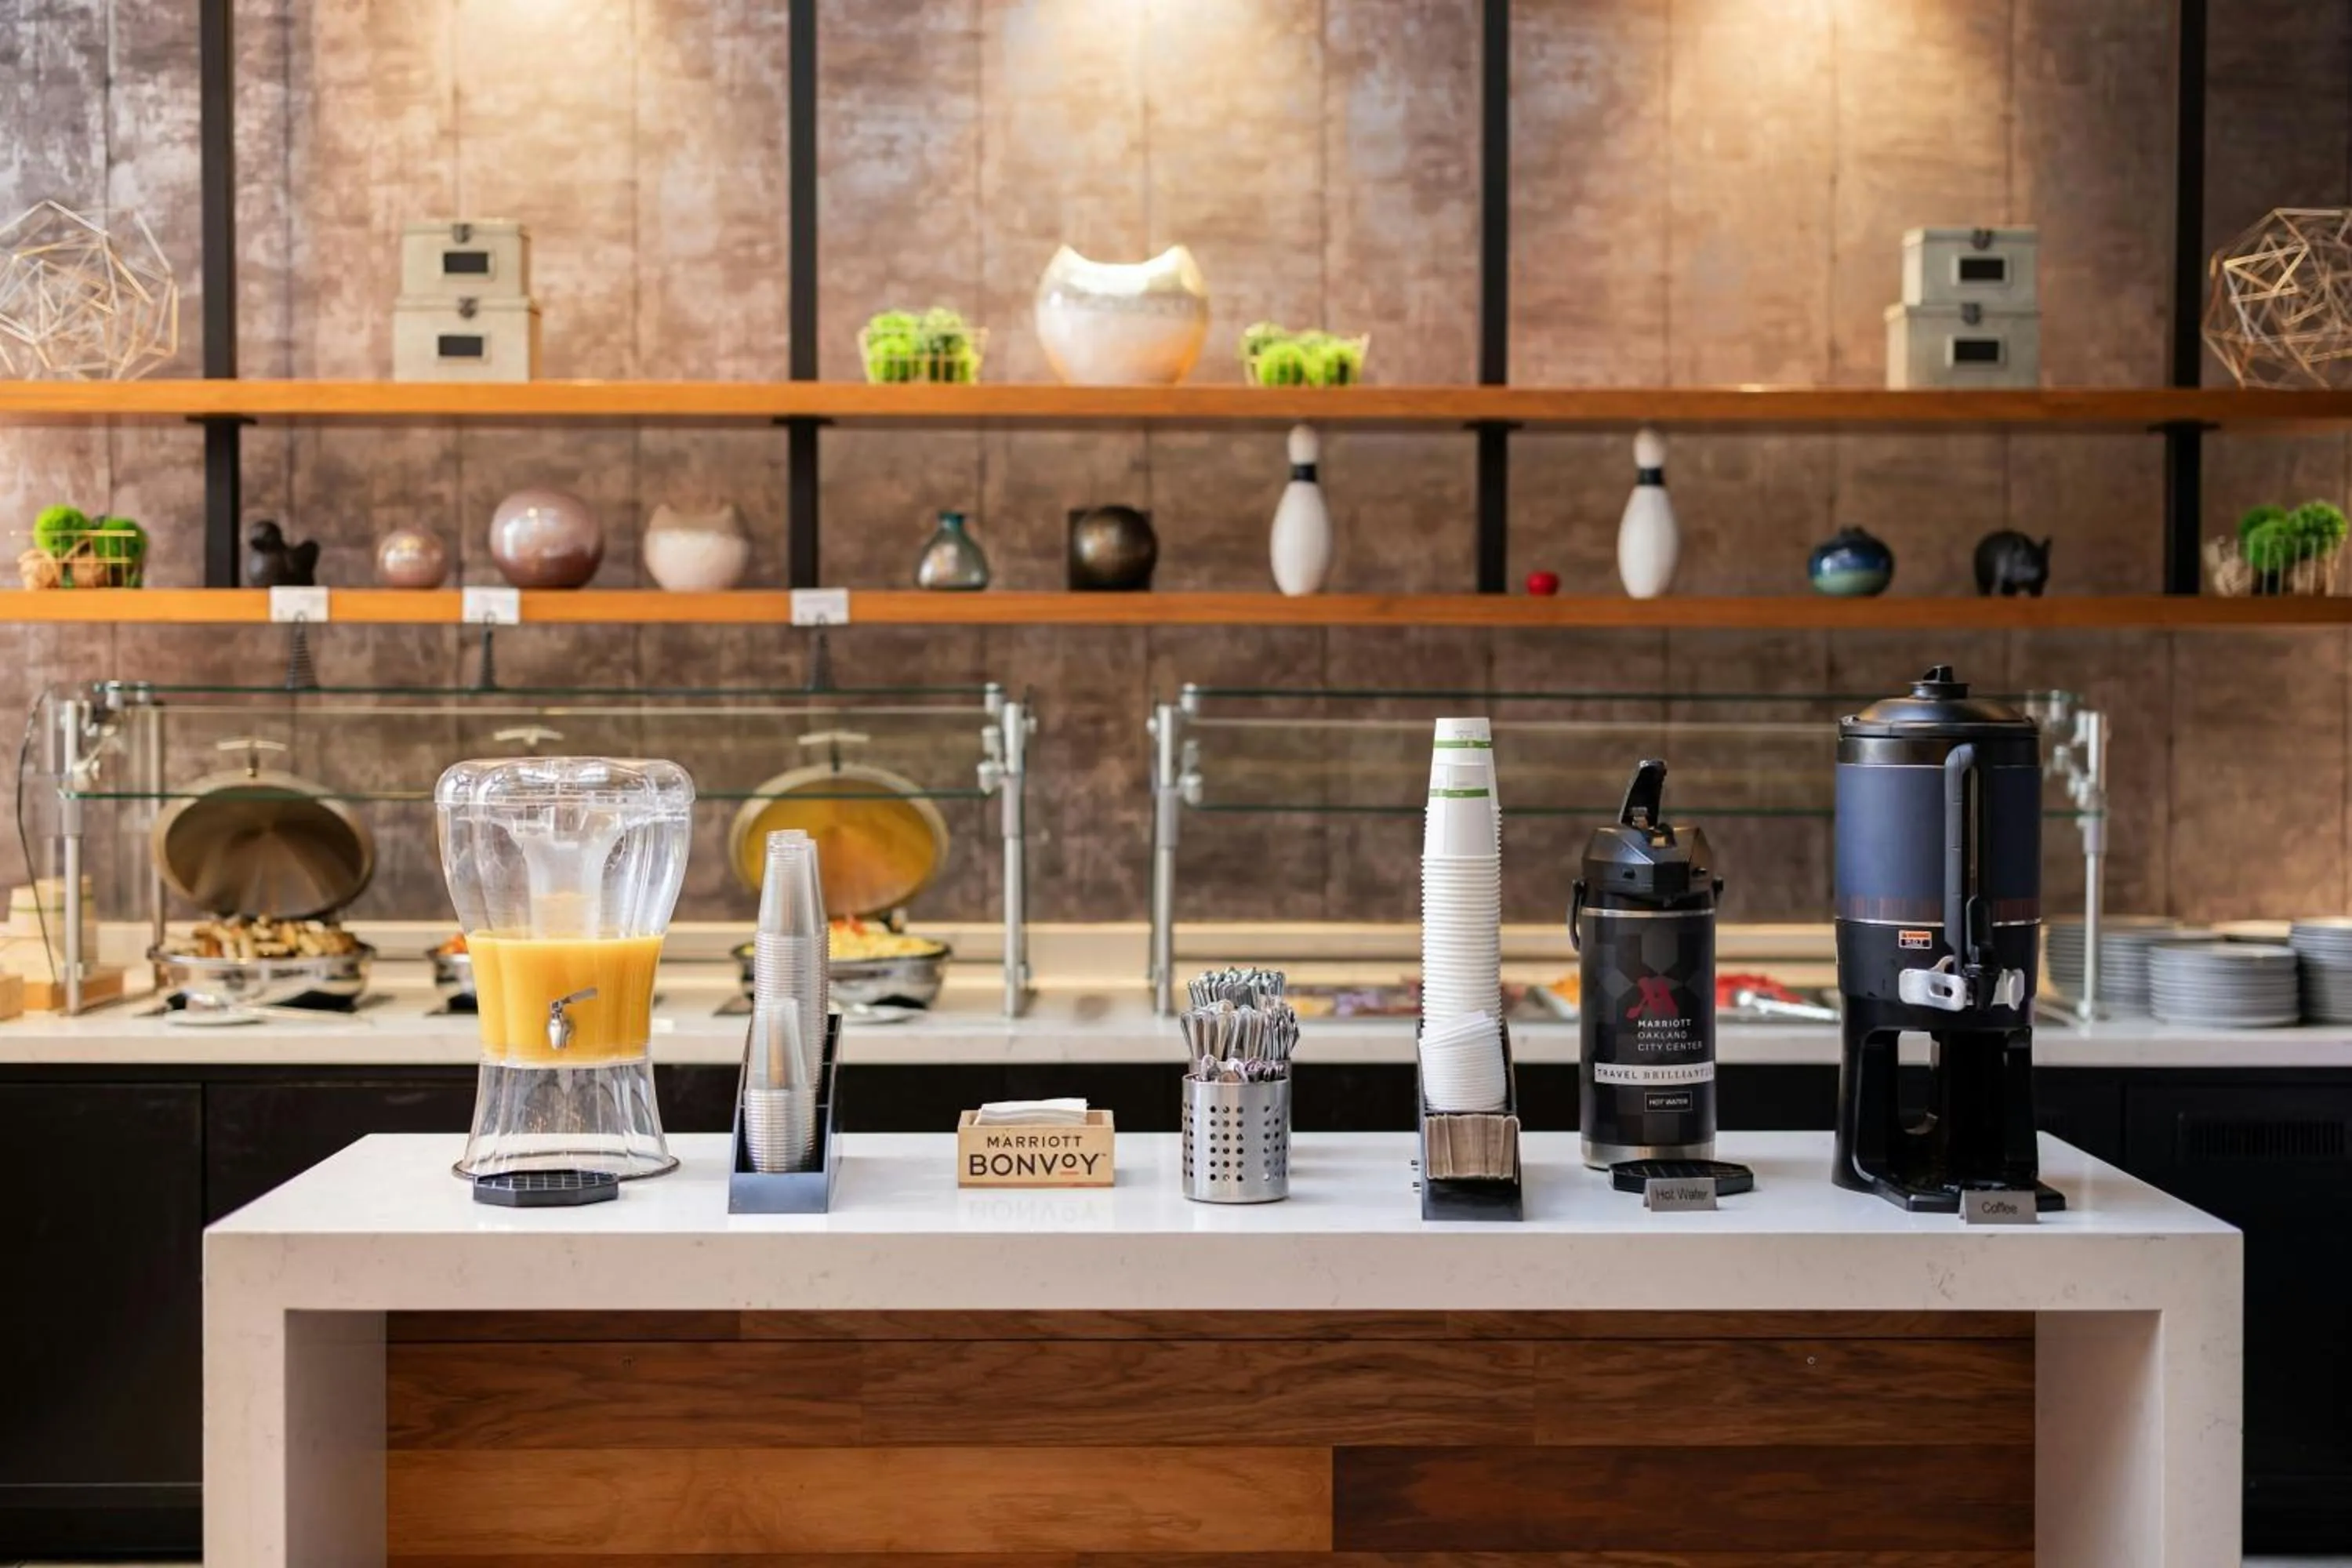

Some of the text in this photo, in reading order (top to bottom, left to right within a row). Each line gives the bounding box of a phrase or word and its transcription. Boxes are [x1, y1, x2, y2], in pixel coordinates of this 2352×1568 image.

[1638, 1018, 1692, 1028] MARRIOTT
[1638, 1030, 1687, 1040] OAKLAND
[1638, 1040, 1703, 1052] CITY CENTER
[1597, 1069, 1638, 1080] TRAVEL
[986, 1135, 1083, 1149] MARRIOTT
[968, 1153, 1099, 1176] BONVOY
[1655, 1187, 1709, 1200] Hot Water
[1981, 1201, 2018, 1214] Coffee
